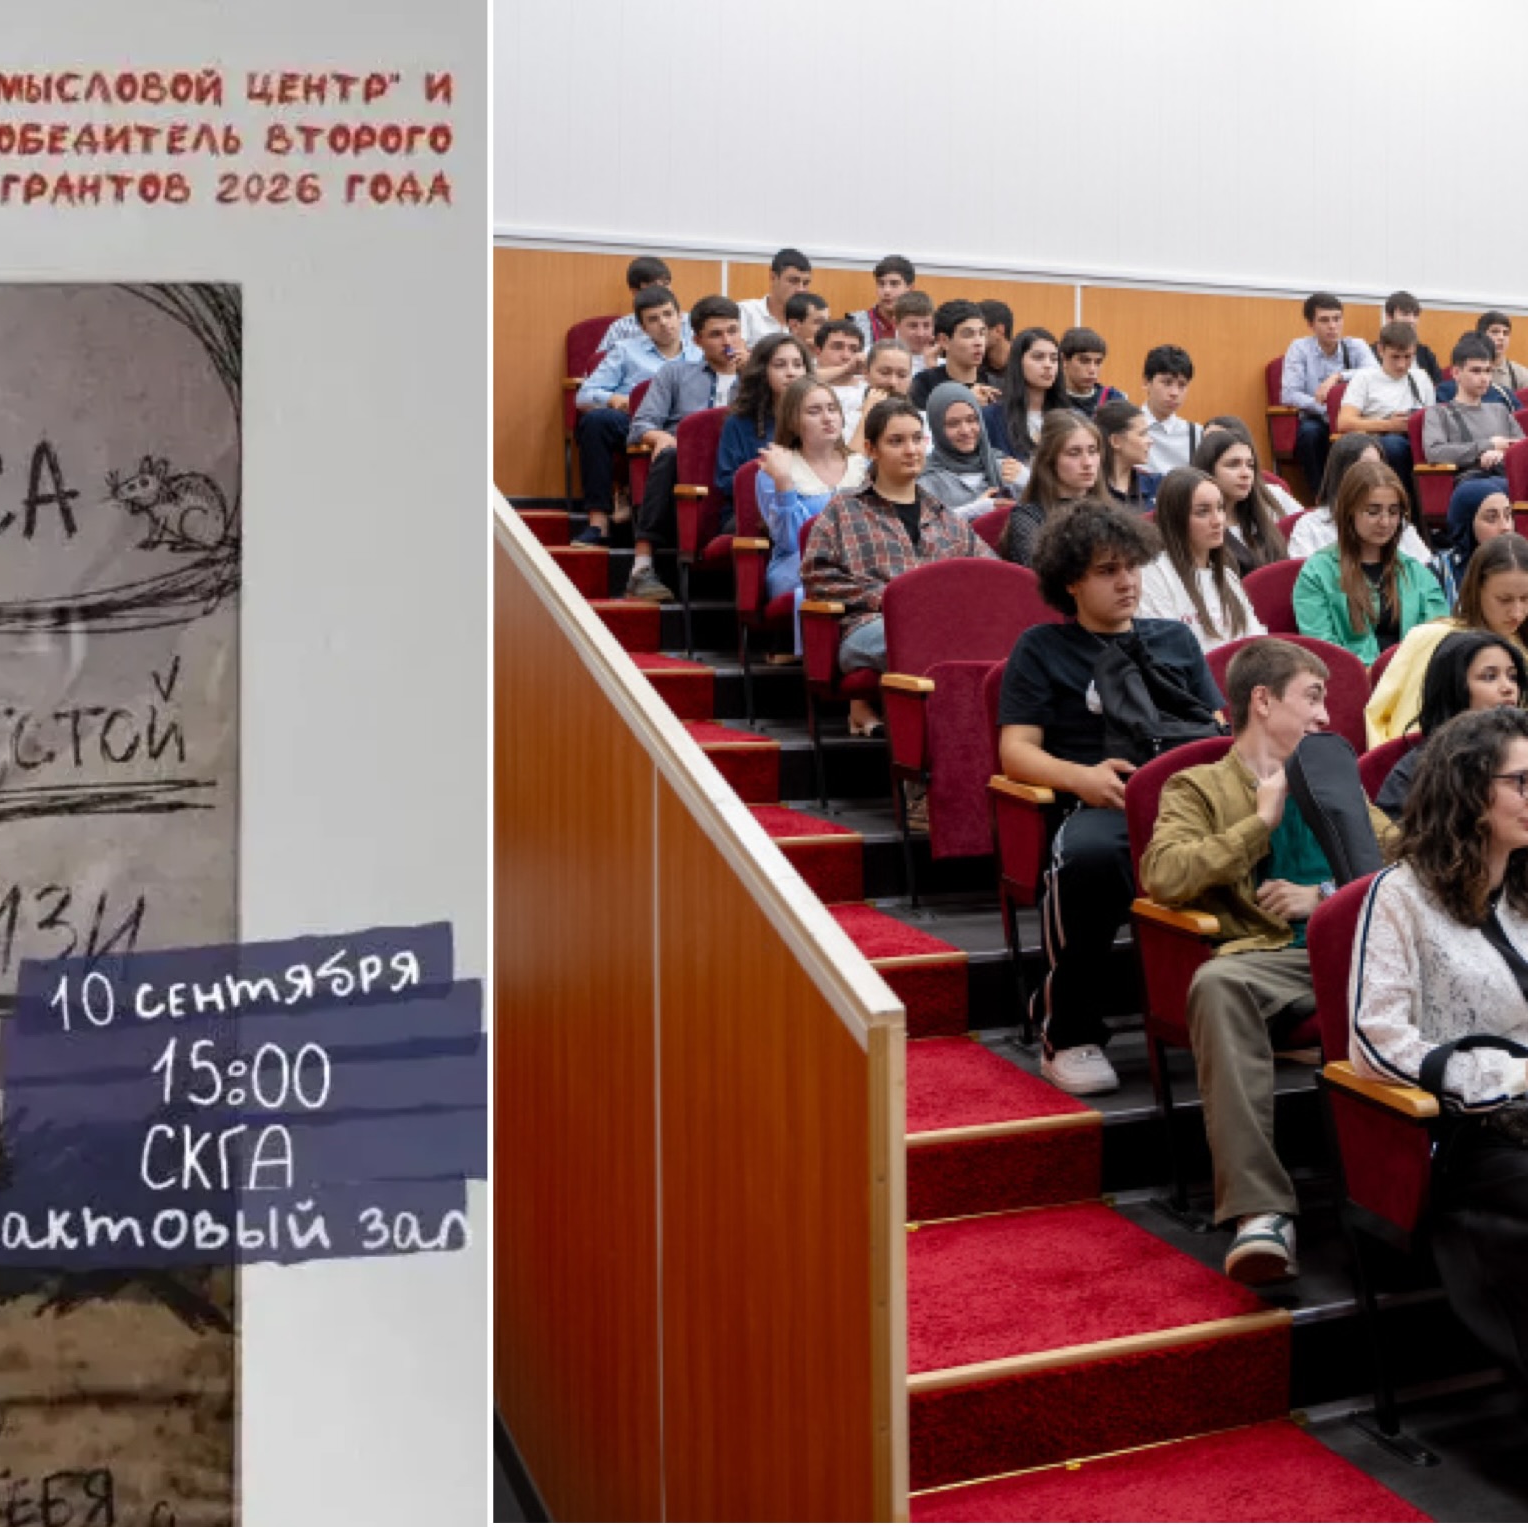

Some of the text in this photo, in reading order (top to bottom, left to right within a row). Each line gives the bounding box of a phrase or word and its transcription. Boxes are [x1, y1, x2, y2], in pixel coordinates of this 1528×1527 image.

[247, 72, 401, 106] ЦЕНТР"
[425, 72, 453, 104] И
[265, 123, 453, 156] ВТОРОГО
[1, 172, 190, 206] ГРАНТОВ
[216, 172, 321, 205] 2026
[345, 172, 453, 206] ГОДА
[51, 972, 114, 1031] 10
[151, 1038, 331, 1107] 15:00
[141, 1124, 293, 1190] СКГА
[1, 1200, 474, 1251] актовый зал
